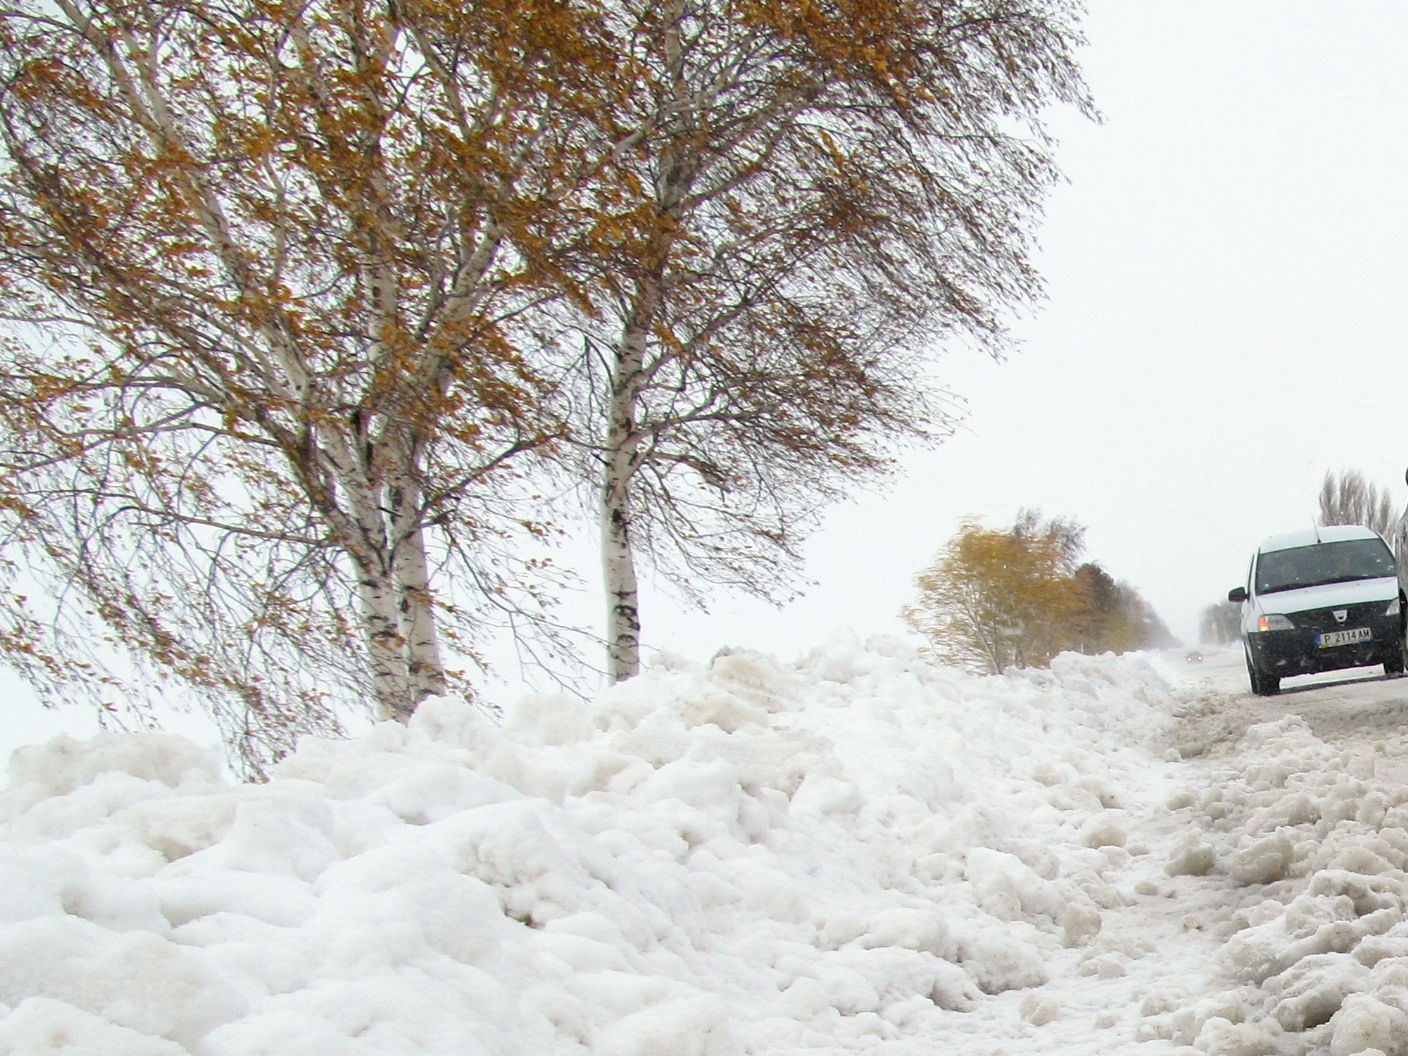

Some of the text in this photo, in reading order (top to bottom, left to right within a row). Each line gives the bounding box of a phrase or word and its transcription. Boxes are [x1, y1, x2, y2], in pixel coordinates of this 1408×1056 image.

[1324, 629, 1370, 643] P 2114 AM
